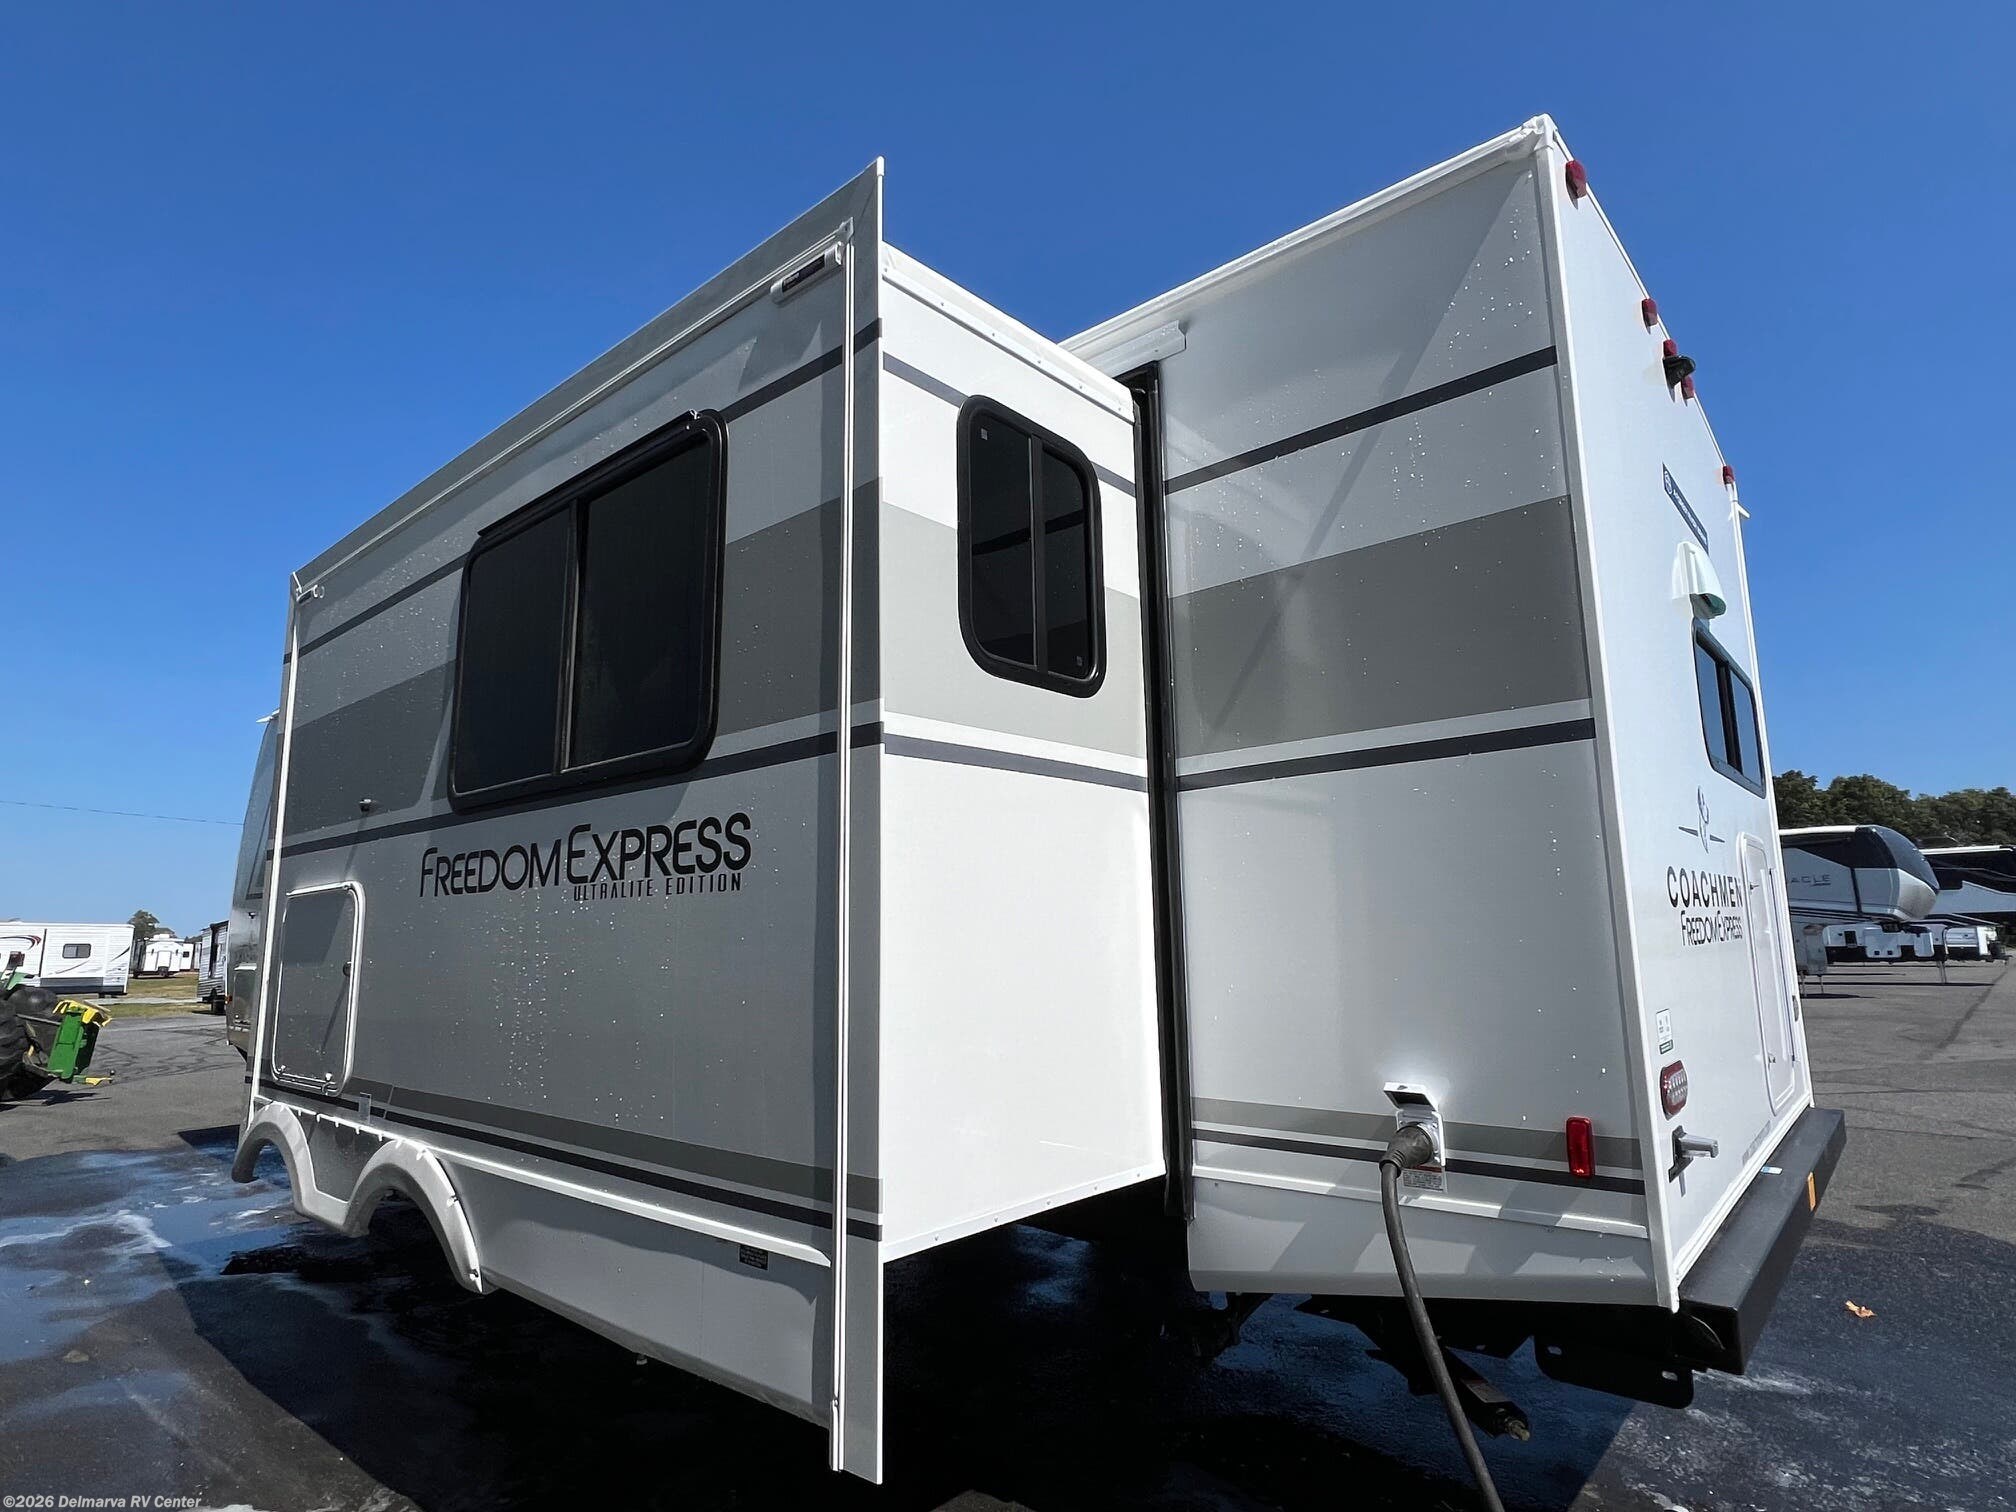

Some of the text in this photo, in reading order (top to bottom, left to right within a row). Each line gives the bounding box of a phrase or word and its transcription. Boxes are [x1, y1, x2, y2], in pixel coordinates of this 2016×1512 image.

[573, 872, 742, 901] ULTRALITE EDITION
[1667, 866, 1743, 908] COACHMEN
